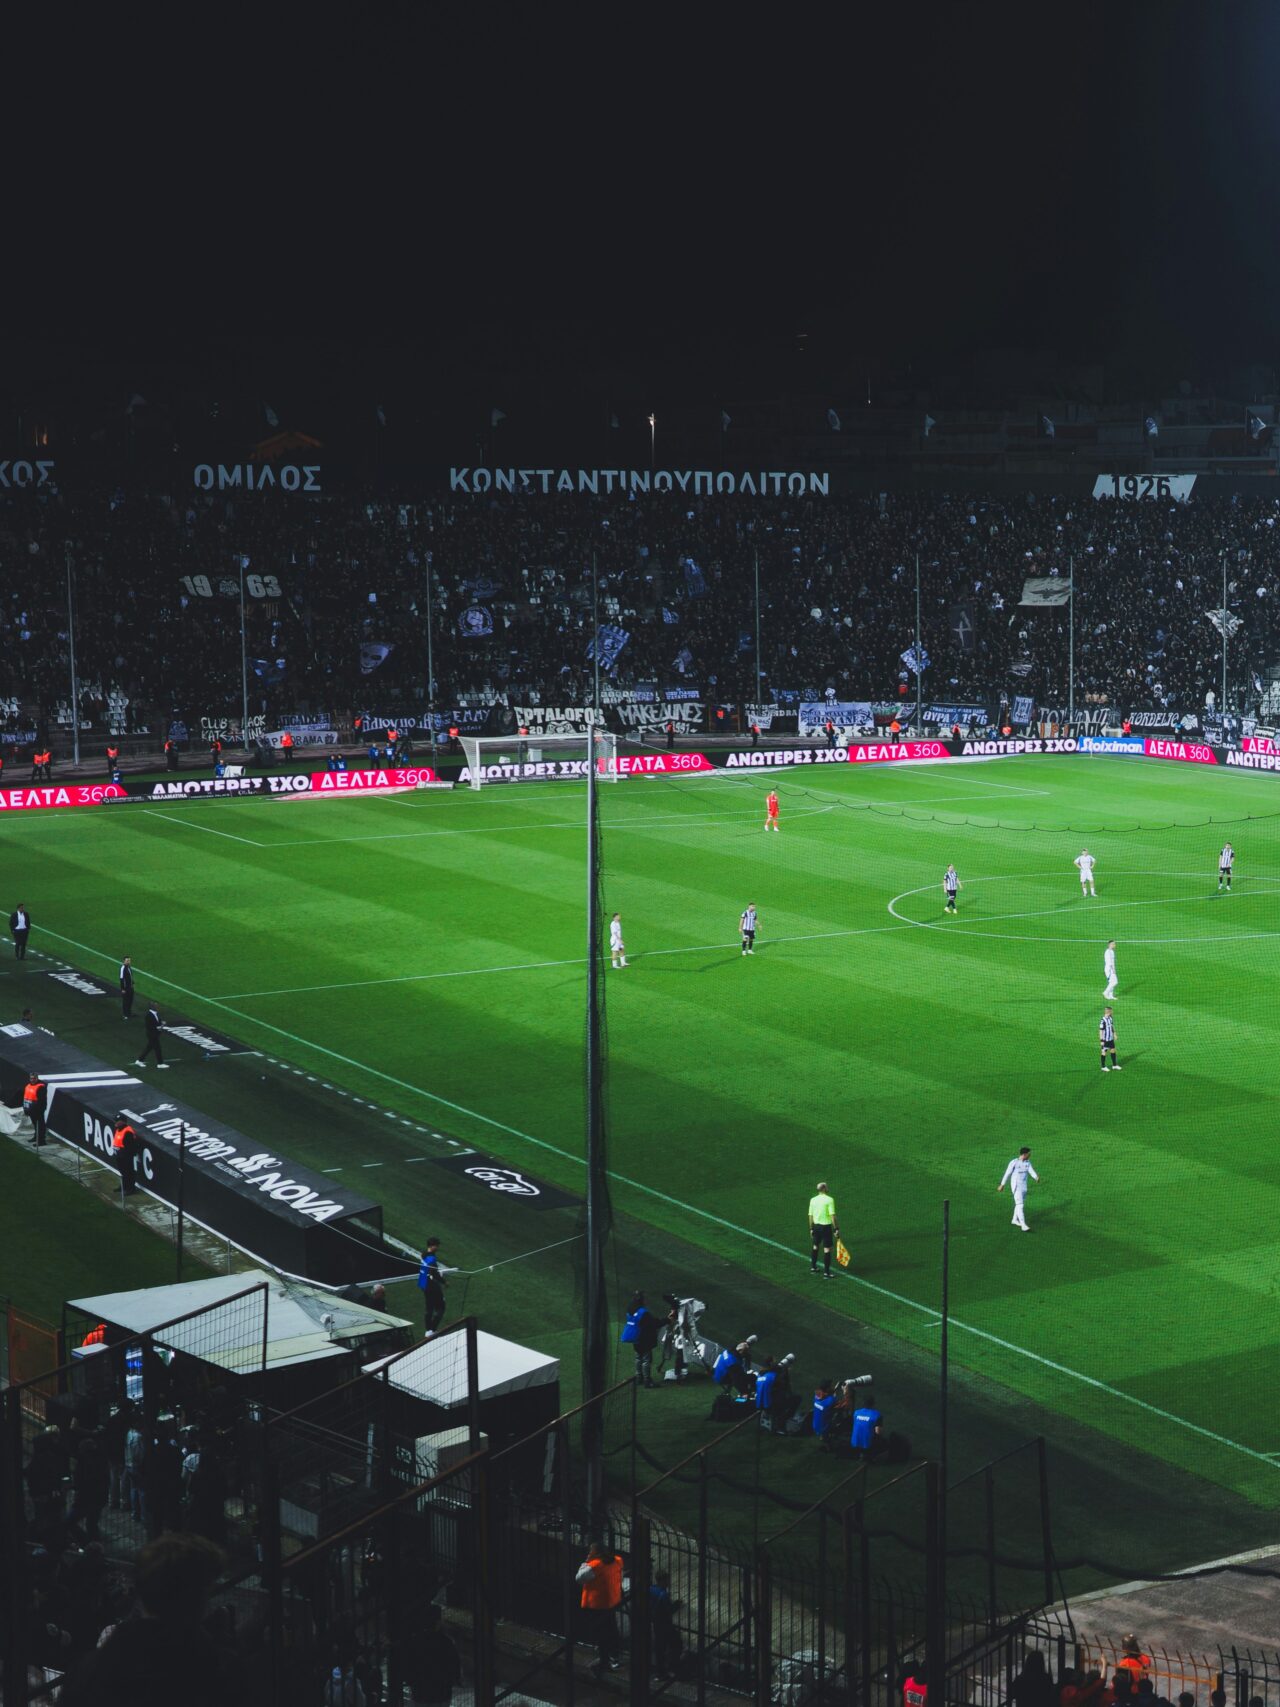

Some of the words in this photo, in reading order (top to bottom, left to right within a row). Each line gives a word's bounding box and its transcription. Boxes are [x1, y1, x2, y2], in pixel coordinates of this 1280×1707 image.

[194, 465, 321, 491] ΟΜΙΛΟΣ
[1111, 475, 1171, 501] 1926
[179, 575, 213, 598] 19
[246, 574, 282, 598] 63
[923, 710, 951, 723] ΘΥΡΑ
[856, 745, 908, 760] ΔΕΛΤΑ
[913, 743, 941, 757] 360
[962, 740, 1042, 755] ΑΝΩΤΕΡΕΣ
[1045, 738, 1080, 752] ΣΧΟ
[1080, 738, 1142, 753] Stoiximan
[1149, 738, 1186, 758] ΔΕΛΤΑ
[1189, 746, 1210, 761] 360
[671, 754, 701, 769] 360
[726, 749, 812, 768] ΑΝΩΤΕΡΕΣ
[815, 748, 850, 763] ΣΧΟ
[267, 775, 313, 792] ΣΧΟ
[321, 771, 389, 789] ΔΕΛΤΑ
[395, 769, 431, 785] 360
[78, 786, 118, 802] 360
[84, 1112, 115, 1157] PAO
[146, 1117, 237, 1161] macron
[246, 1172, 344, 1222] NOVA
